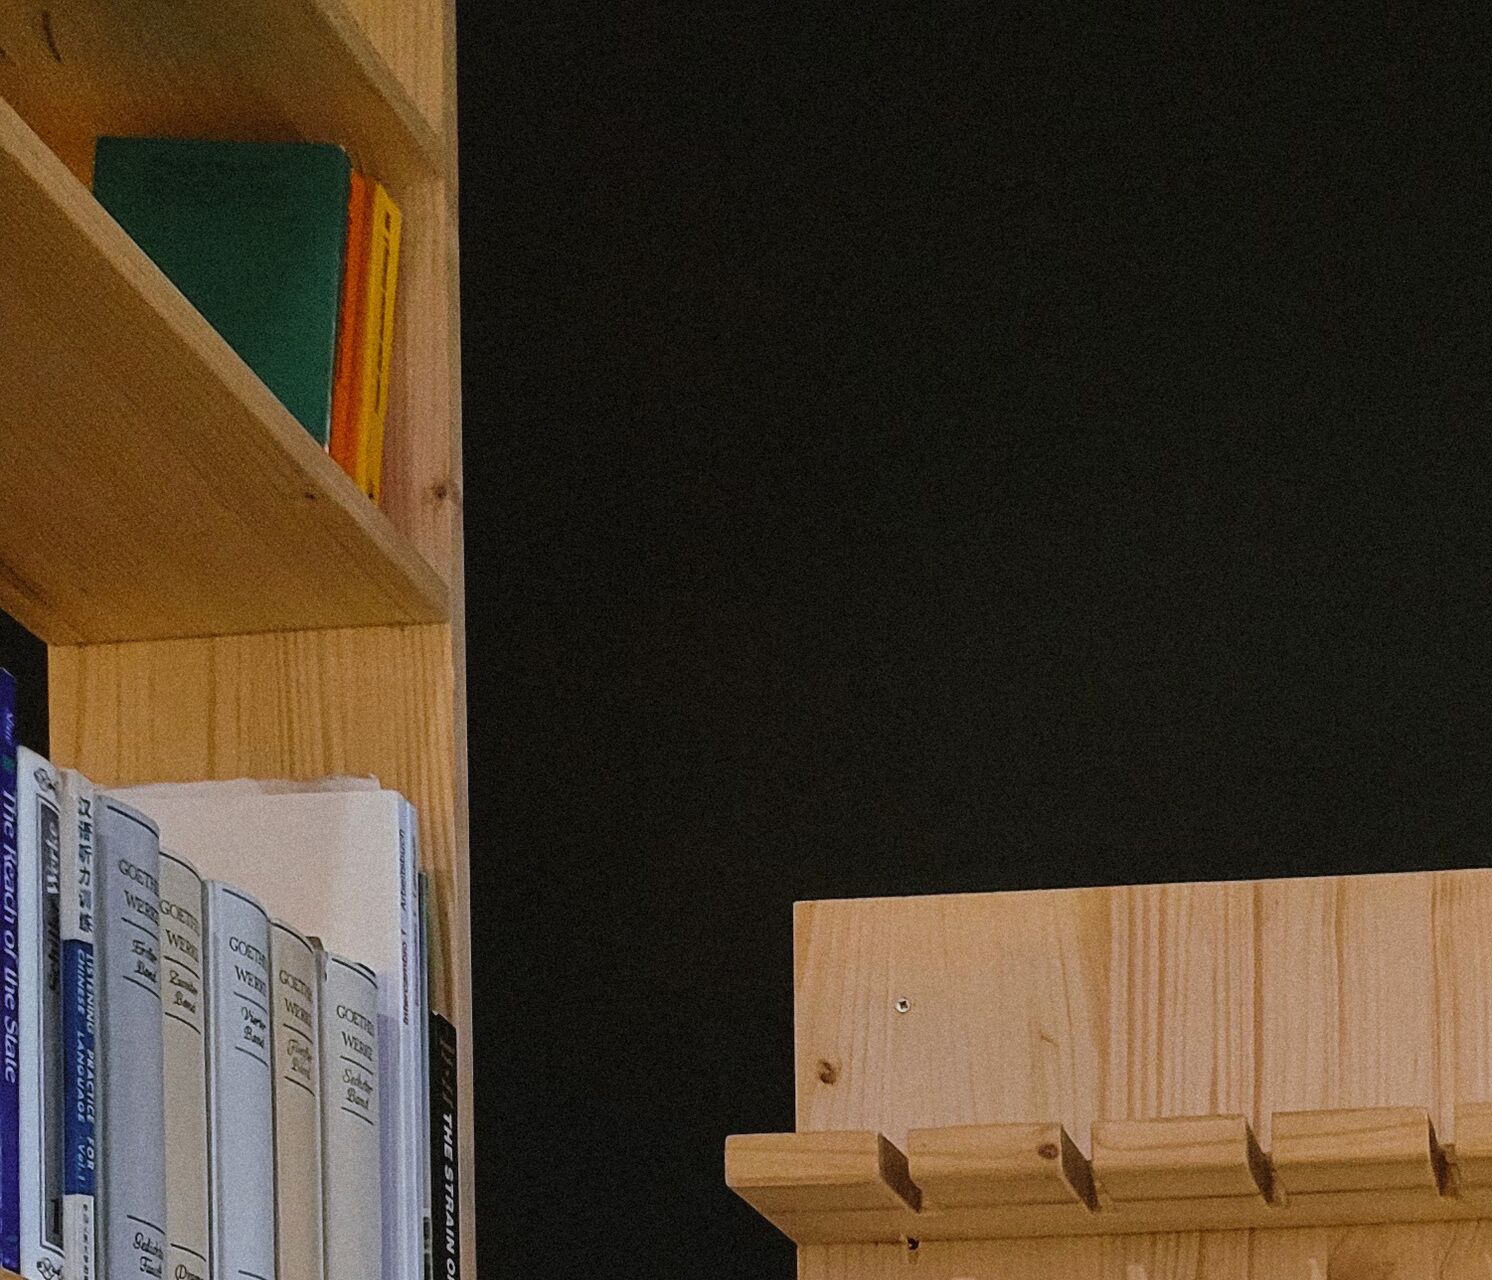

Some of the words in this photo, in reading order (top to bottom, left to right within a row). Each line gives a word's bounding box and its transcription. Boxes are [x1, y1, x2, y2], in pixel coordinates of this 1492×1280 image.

[3, 790, 18, 835] The
[3, 844, 18, 920] Reach
[3, 930, 17, 961] of
[4, 966, 17, 1010] the
[4, 1016, 17, 1083] State
[443, 1112, 453, 1158] THE
[445, 1165, 455, 1252] STRAIN
